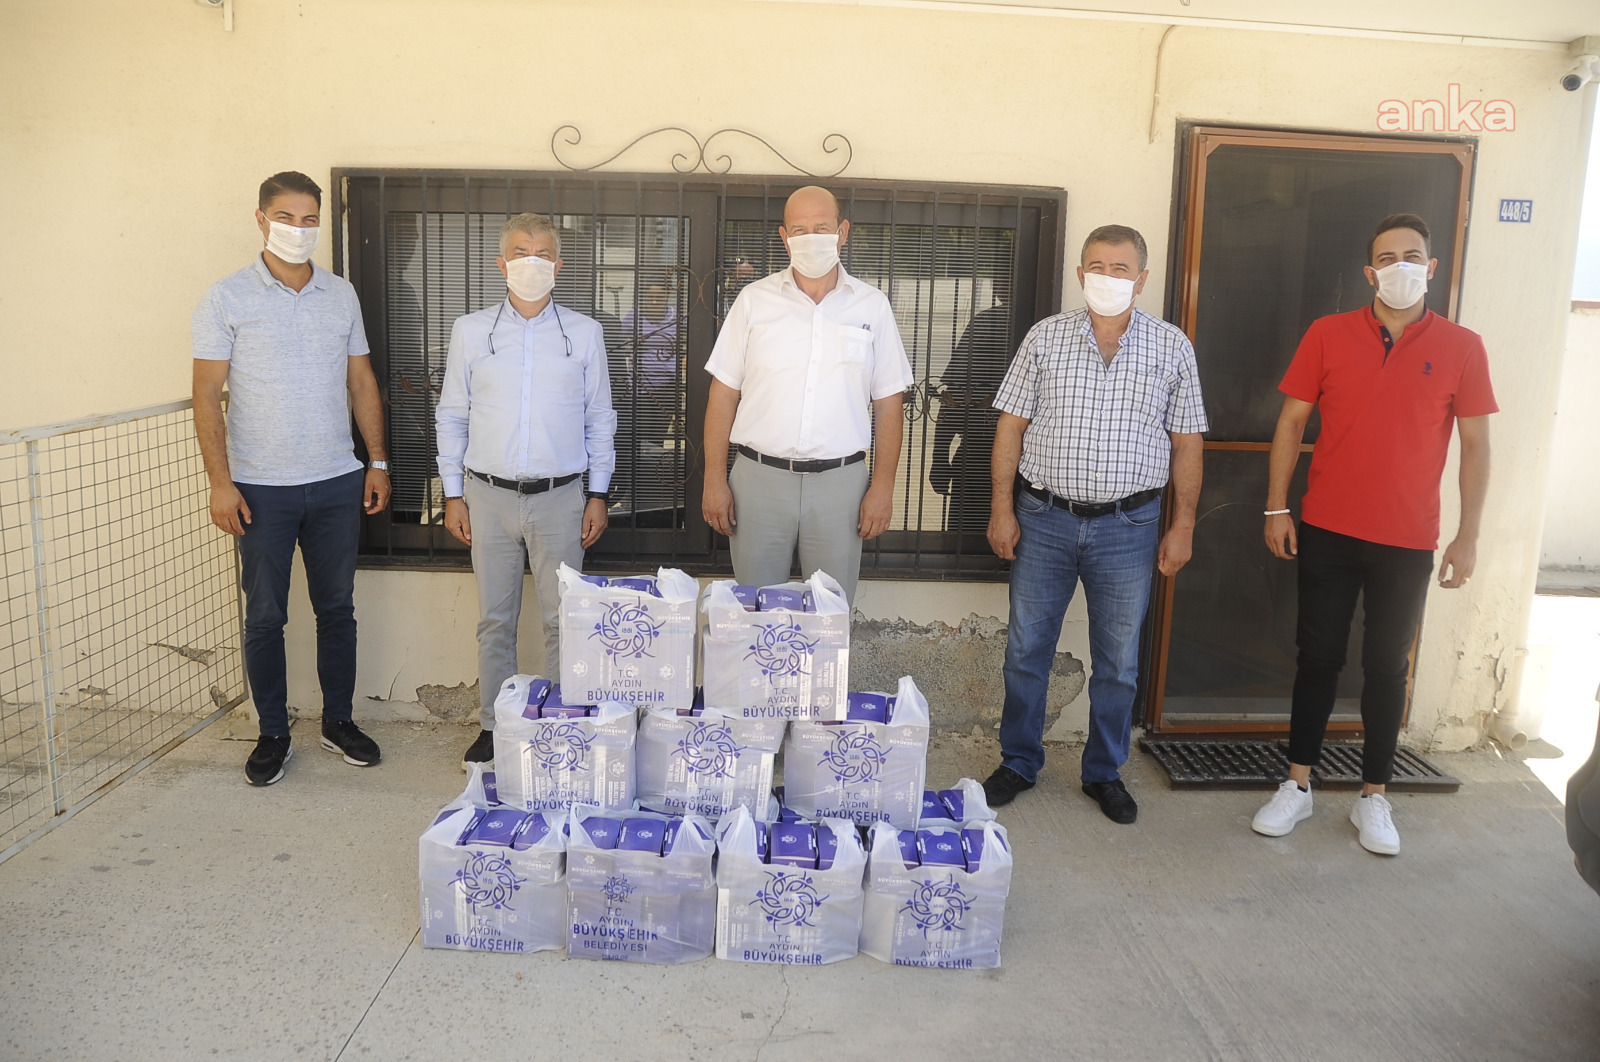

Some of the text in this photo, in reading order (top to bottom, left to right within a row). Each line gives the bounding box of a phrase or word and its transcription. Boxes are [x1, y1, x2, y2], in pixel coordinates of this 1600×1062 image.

[1501, 201, 1530, 222] 448/5
[618, 670, 635, 679] T.C.
[611, 680, 642, 688] AYDIN
[587, 688, 665, 704] BÜYÜKŞEHİR
[767, 696, 798, 704] AYDIN
[743, 704, 820, 719] BÜYÜKŞEHİR
[548, 790, 578, 798] AYDIN
[816, 808, 890, 823] BÜYÜKŞEHİR
[599, 916, 633, 927] AYDIN
[469, 927, 501, 936] AYDIN
[445, 934, 524, 951] BÜYÜKŞEHİR
[769, 943, 800, 951] AYDIN
[743, 949, 822, 964] BÜYÜKŞEHİR
[920, 950, 951, 958] AYDIN
